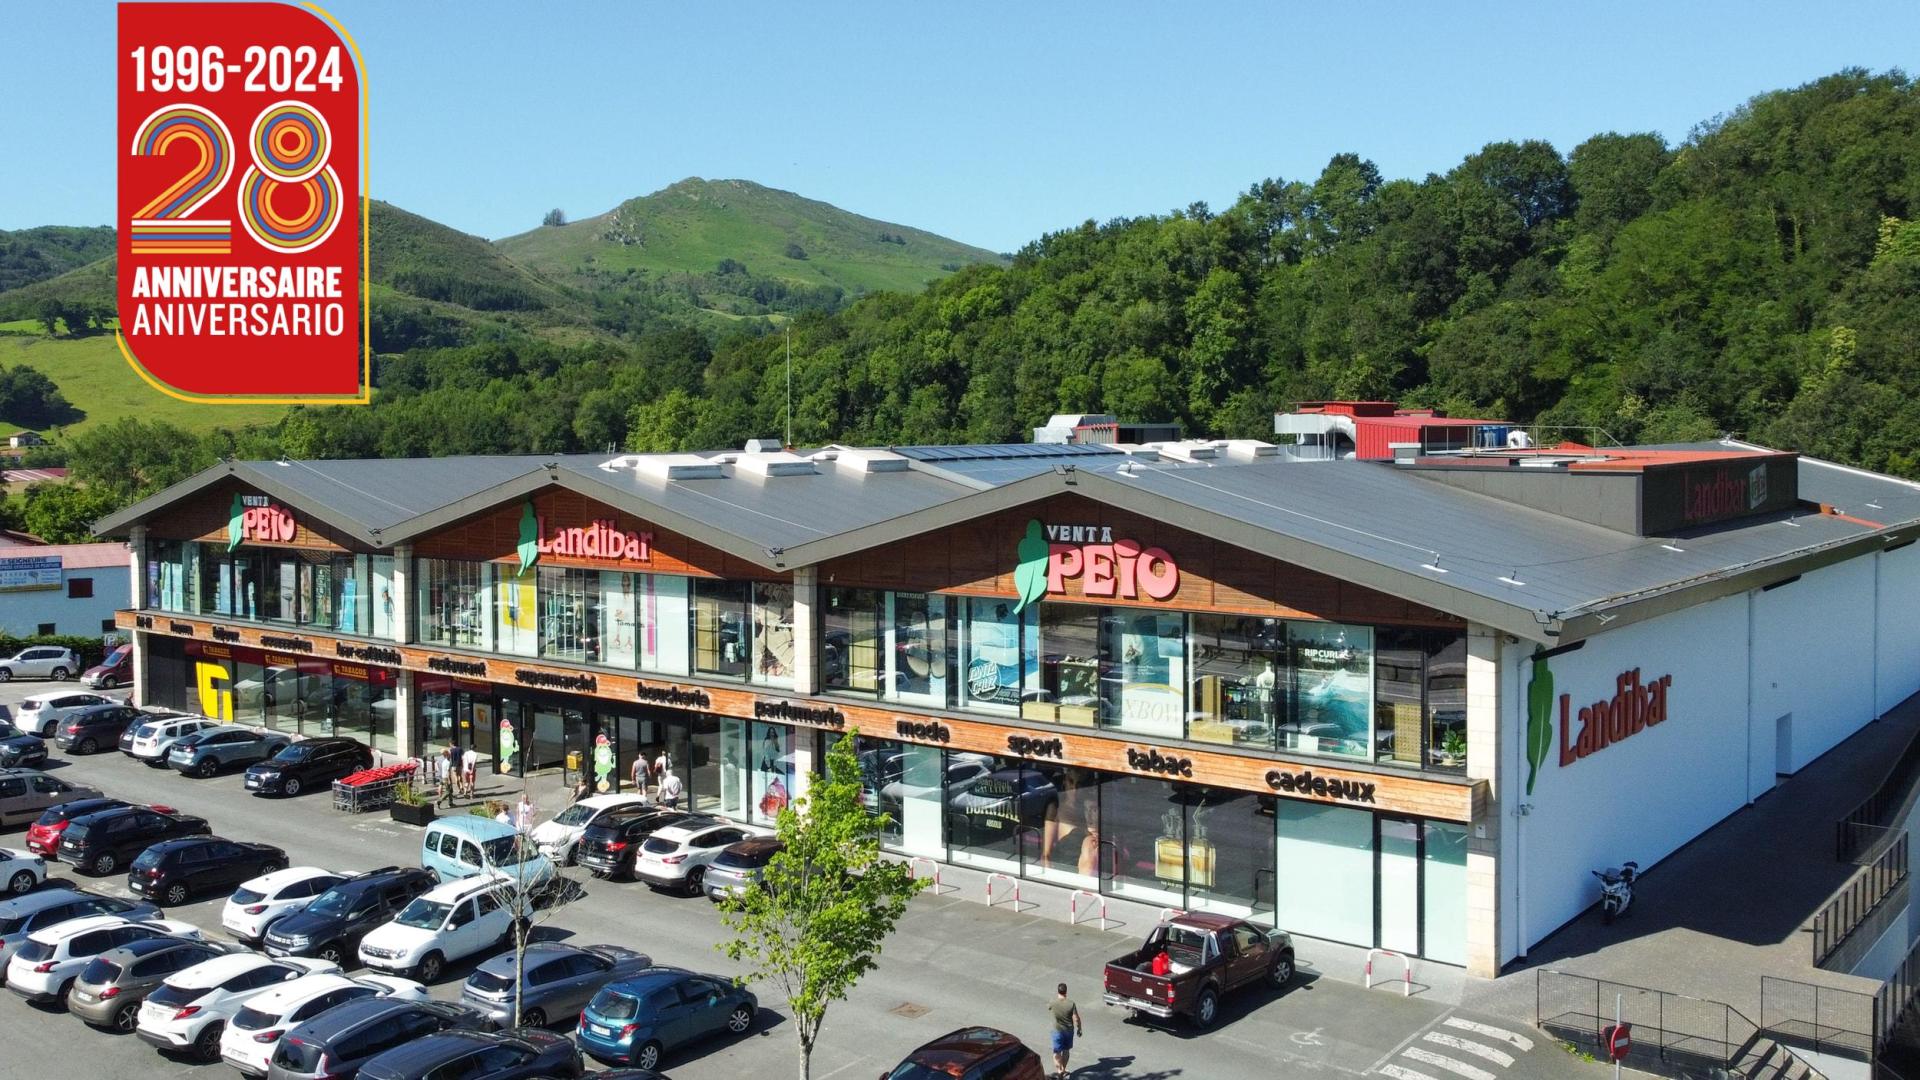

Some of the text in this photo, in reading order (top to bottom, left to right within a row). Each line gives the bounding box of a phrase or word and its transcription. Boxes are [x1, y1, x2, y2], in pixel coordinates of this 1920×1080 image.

[242, 495, 269, 507] VENTA
[537, 515, 654, 560] Landibar
[1047, 525, 1113, 542] VENTA
[1304, 649, 1340, 659] RIP CURL
[341, 666, 367, 676] TABACOS
[1559, 667, 1672, 767] Landibar
[1008, 735, 1063, 760] sport
[1127, 748, 1193, 778] tabac
[1264, 769, 1376, 804] cadeaux
